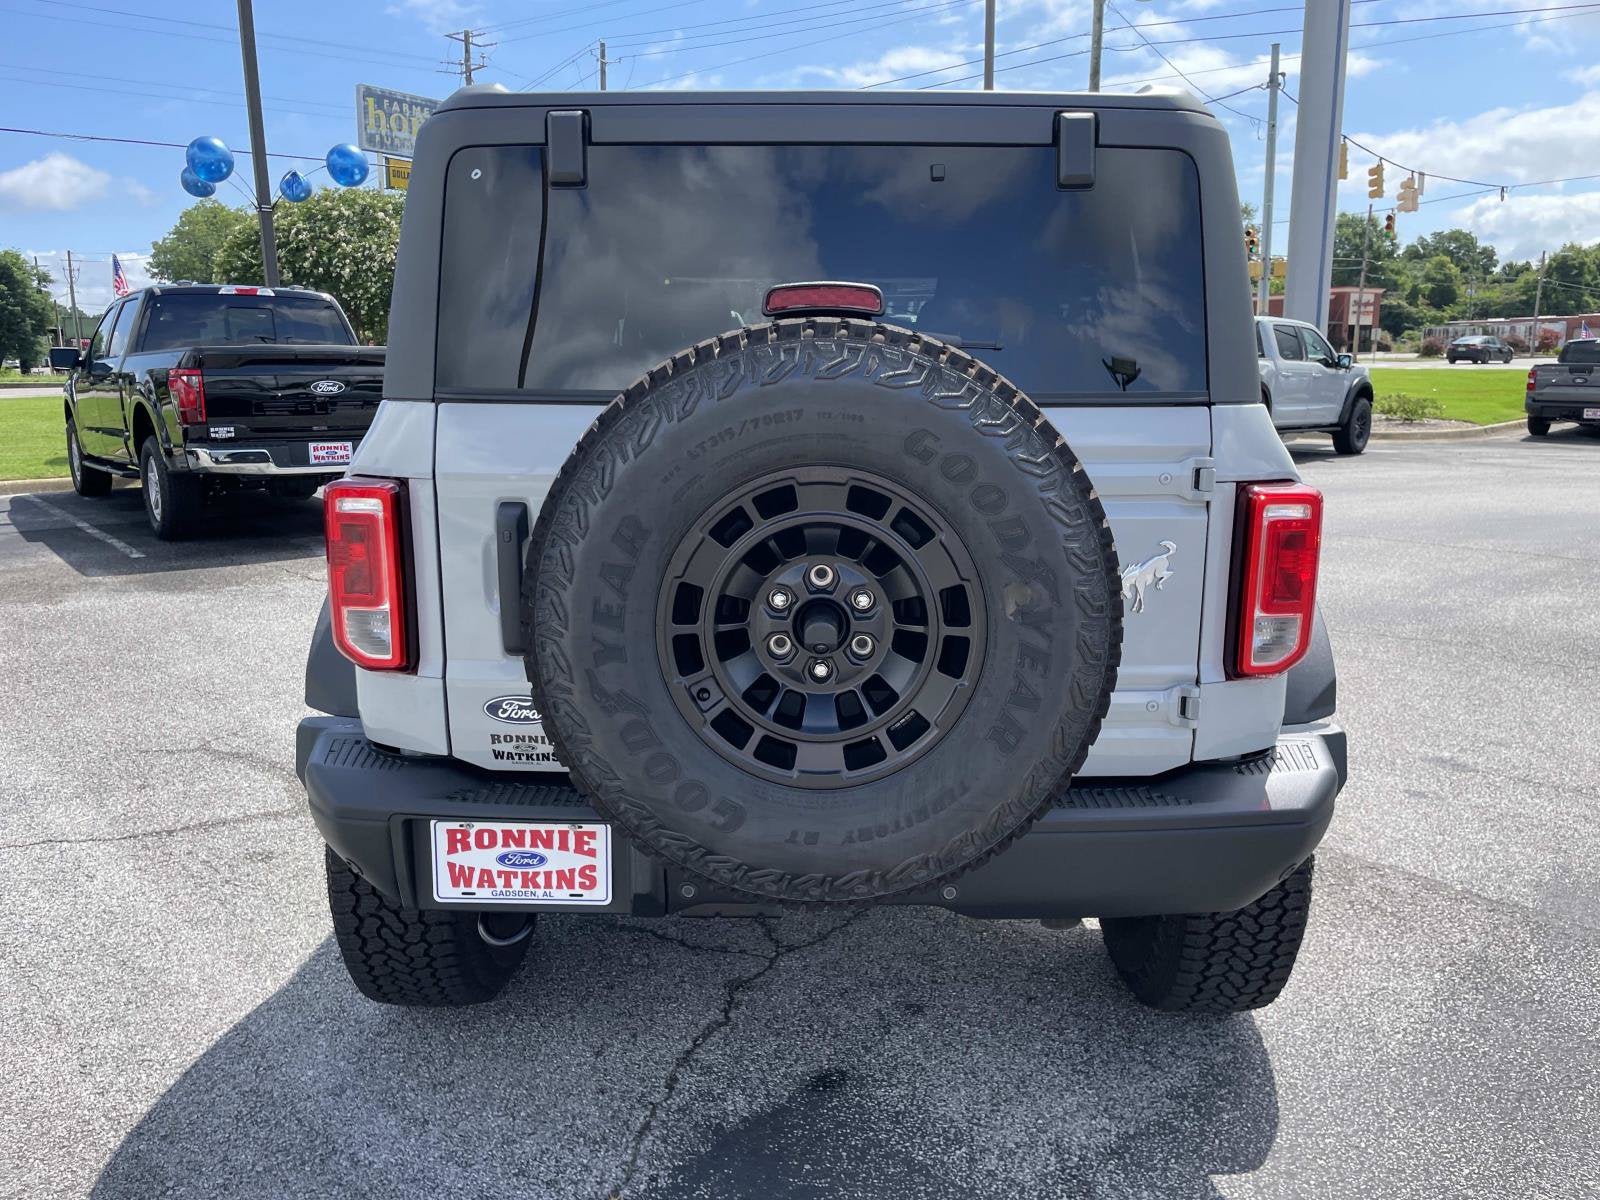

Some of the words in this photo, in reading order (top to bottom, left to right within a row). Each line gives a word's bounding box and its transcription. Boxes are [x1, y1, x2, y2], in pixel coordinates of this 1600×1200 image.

[383, 99, 432, 119] FARME
[317, 382, 339, 392] Ford
[902, 428, 1061, 757] GOODYEAR
[584, 514, 748, 833] GOODYEAR
[489, 733, 550, 745] RONNI
[446, 828, 597, 858] RONNIE
[503, 852, 541, 866] Ford
[446, 861, 598, 890] WATKINS
[491, 889, 540, 899] GADSDEN,
[542, 890, 555, 898] AL
